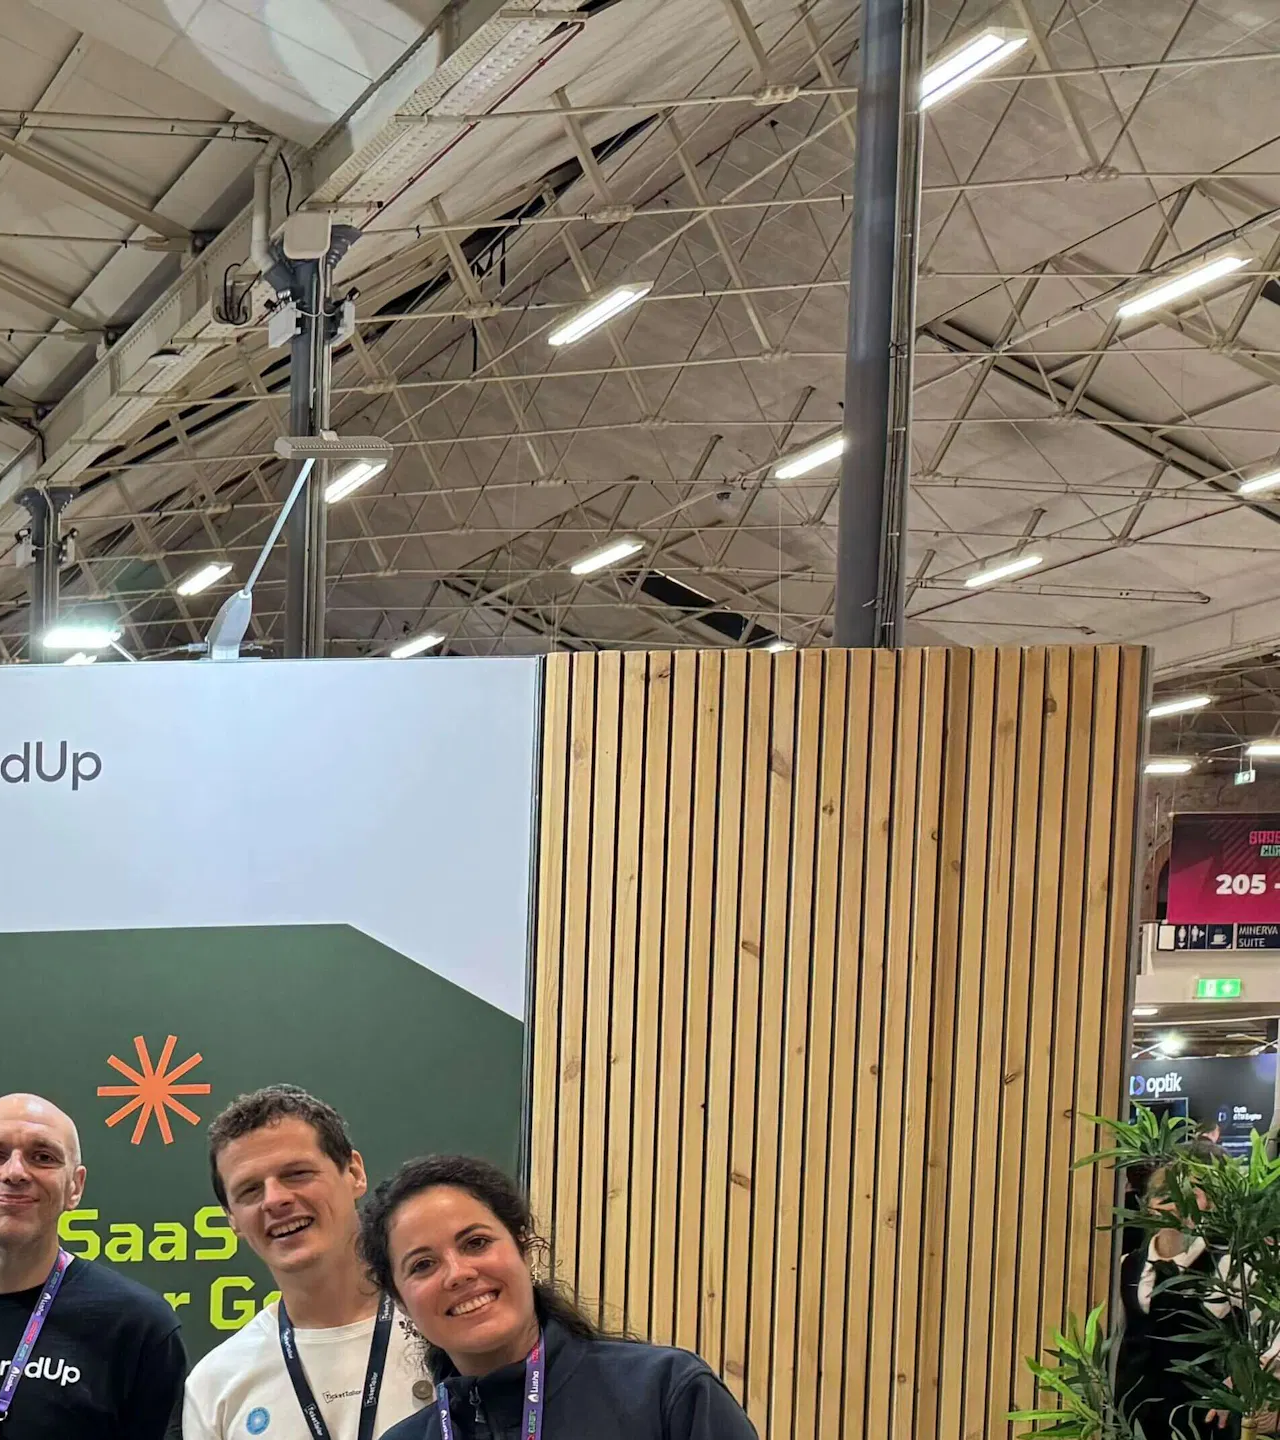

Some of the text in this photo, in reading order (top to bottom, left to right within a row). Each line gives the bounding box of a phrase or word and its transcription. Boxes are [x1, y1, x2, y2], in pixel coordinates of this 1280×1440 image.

[1216, 874, 1266, 895] 205
[1239, 926, 1278, 936] MINERVA
[1239, 938, 1265, 948] SUITE
[1146, 1072, 1182, 1098] optik
